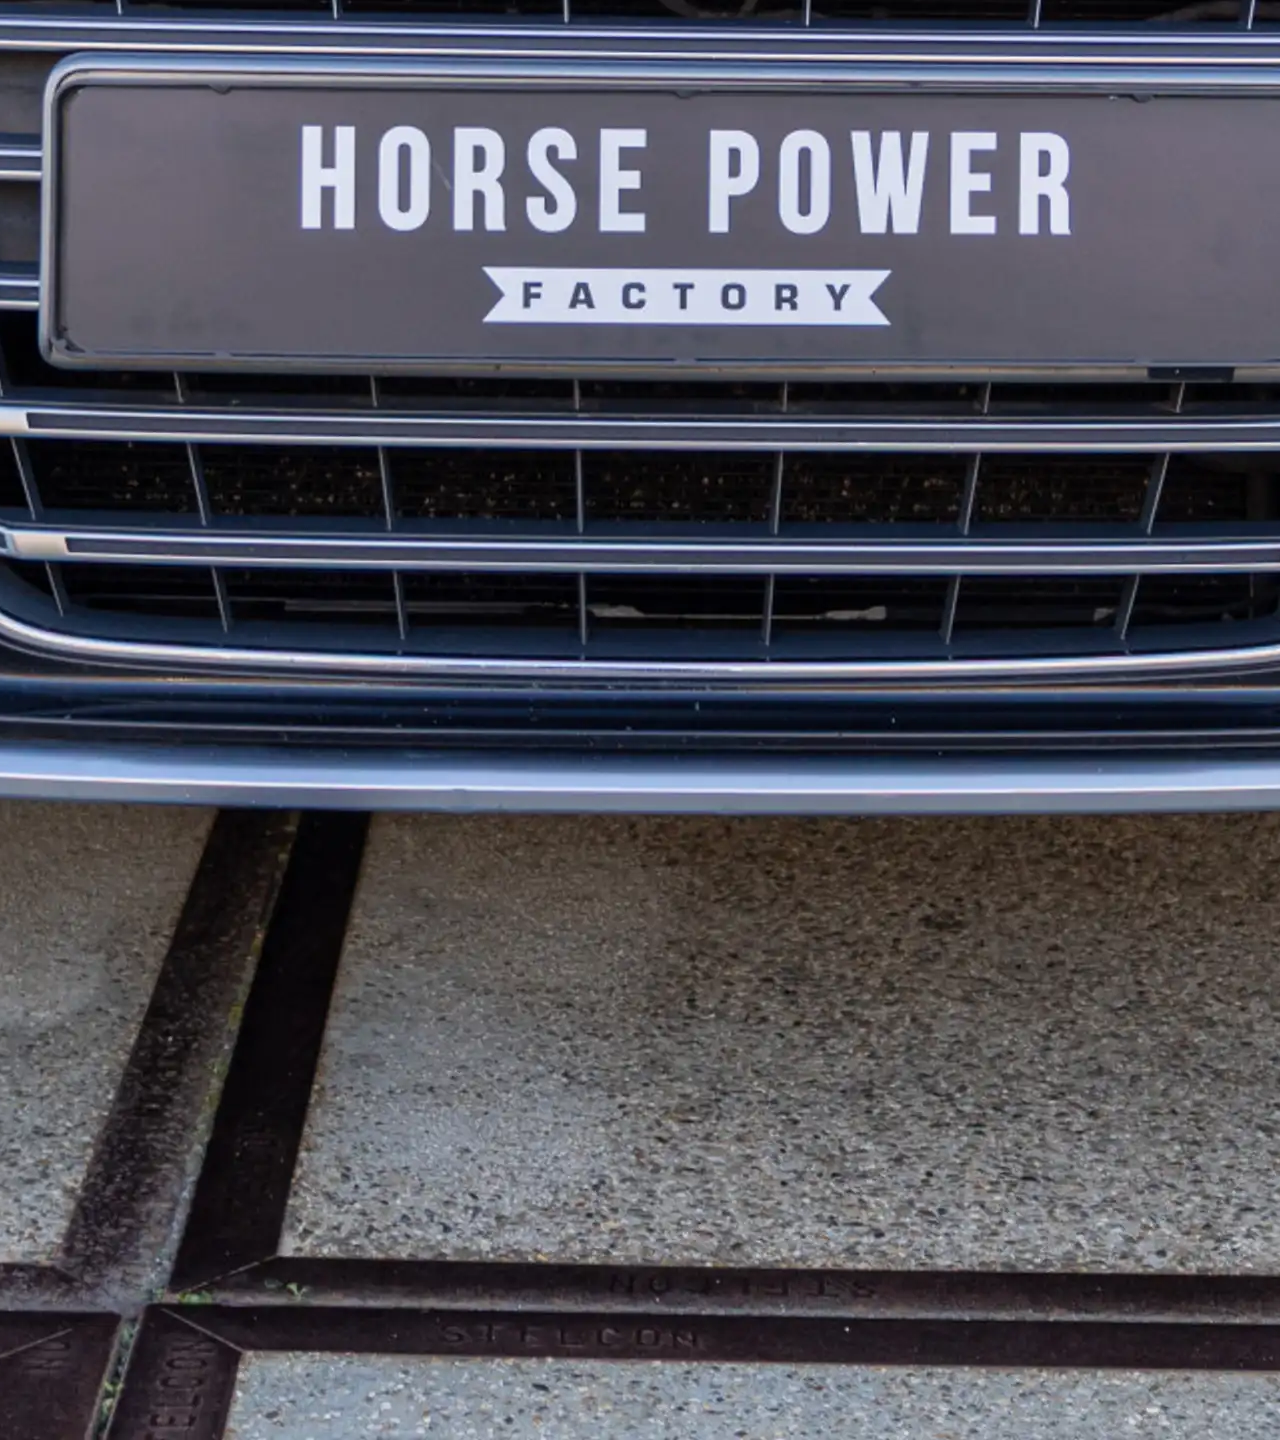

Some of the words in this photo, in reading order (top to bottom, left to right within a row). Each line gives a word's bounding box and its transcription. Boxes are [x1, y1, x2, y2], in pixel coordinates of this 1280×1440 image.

[301, 124, 648, 233] HORSE
[708, 128, 1072, 236] POWER
[521, 281, 852, 312] FACTORY
[440, 1324, 700, 1350] STELCON
